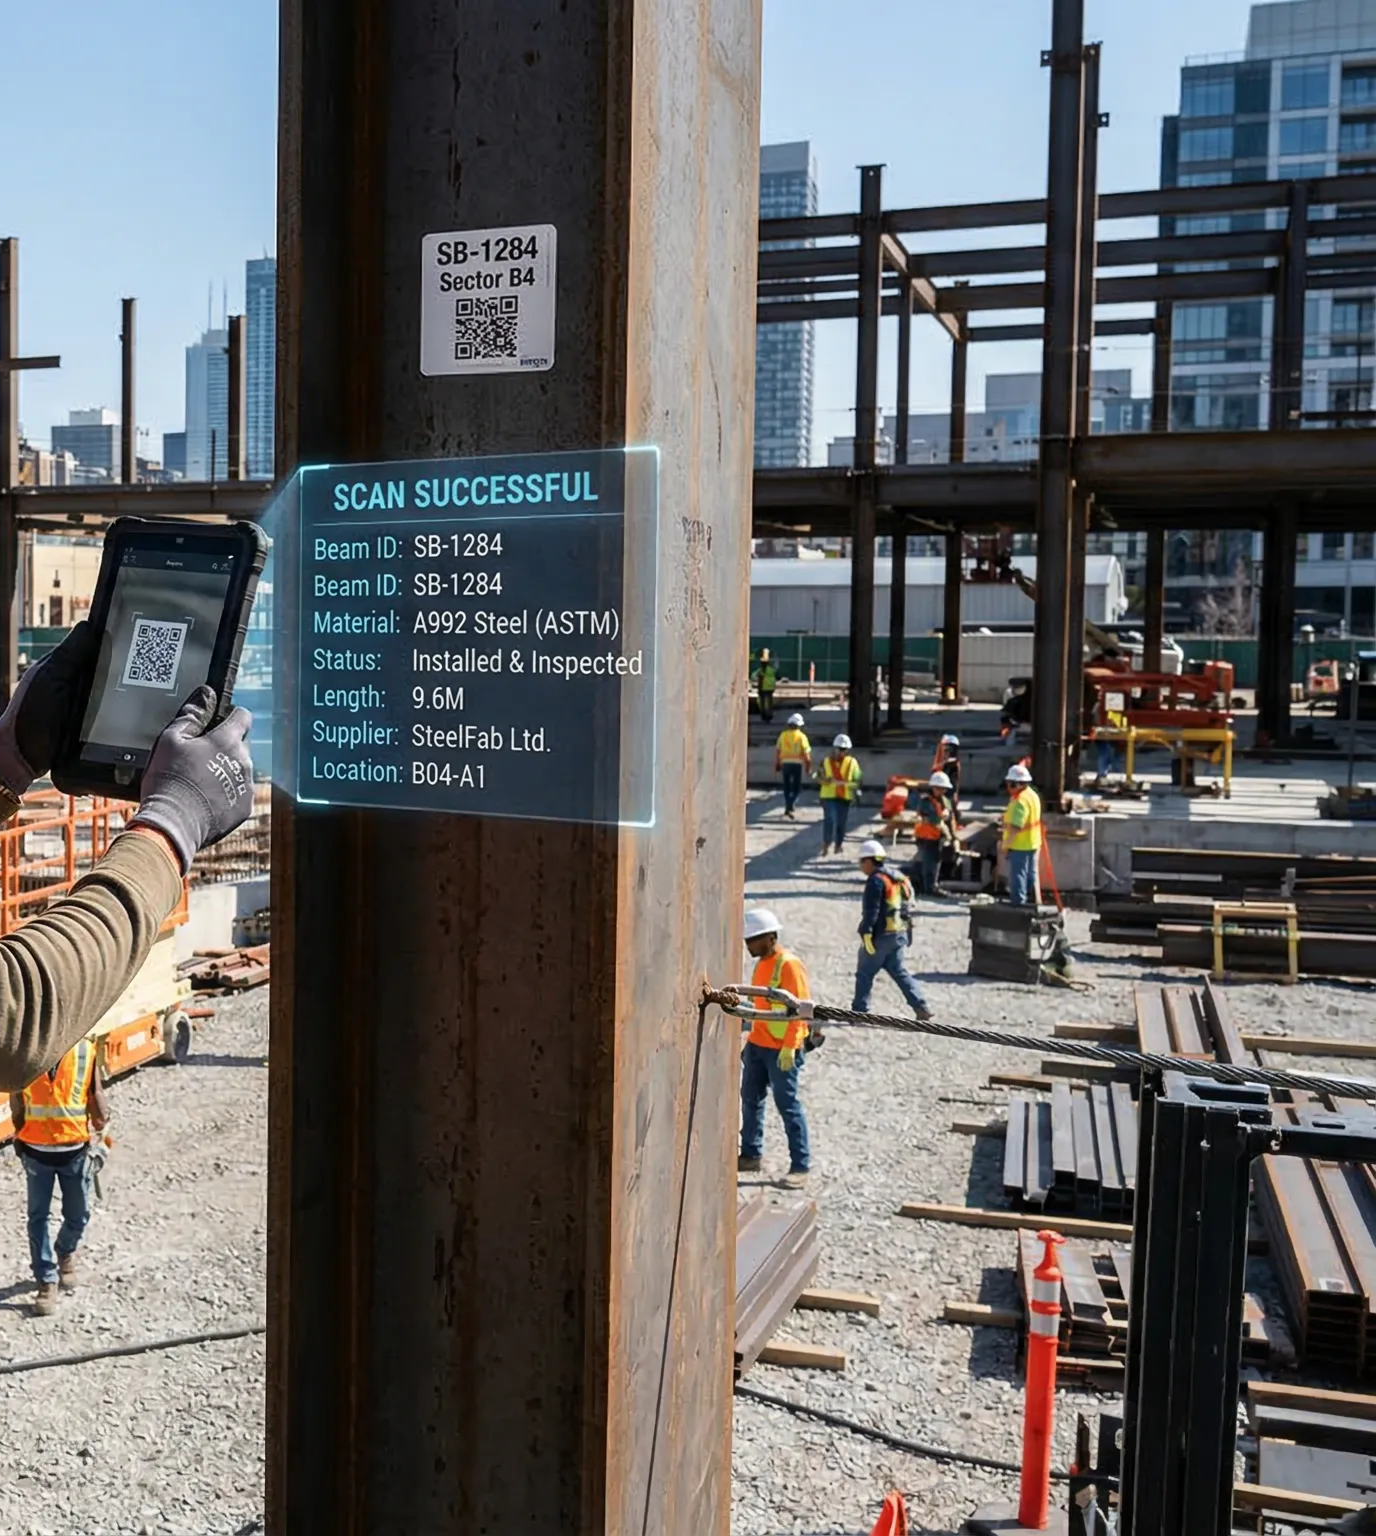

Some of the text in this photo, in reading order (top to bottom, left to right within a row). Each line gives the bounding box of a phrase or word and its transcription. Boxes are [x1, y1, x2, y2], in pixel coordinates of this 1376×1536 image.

[437, 235, 538, 266] SB-1284
[440, 267, 536, 292] Sector B4
